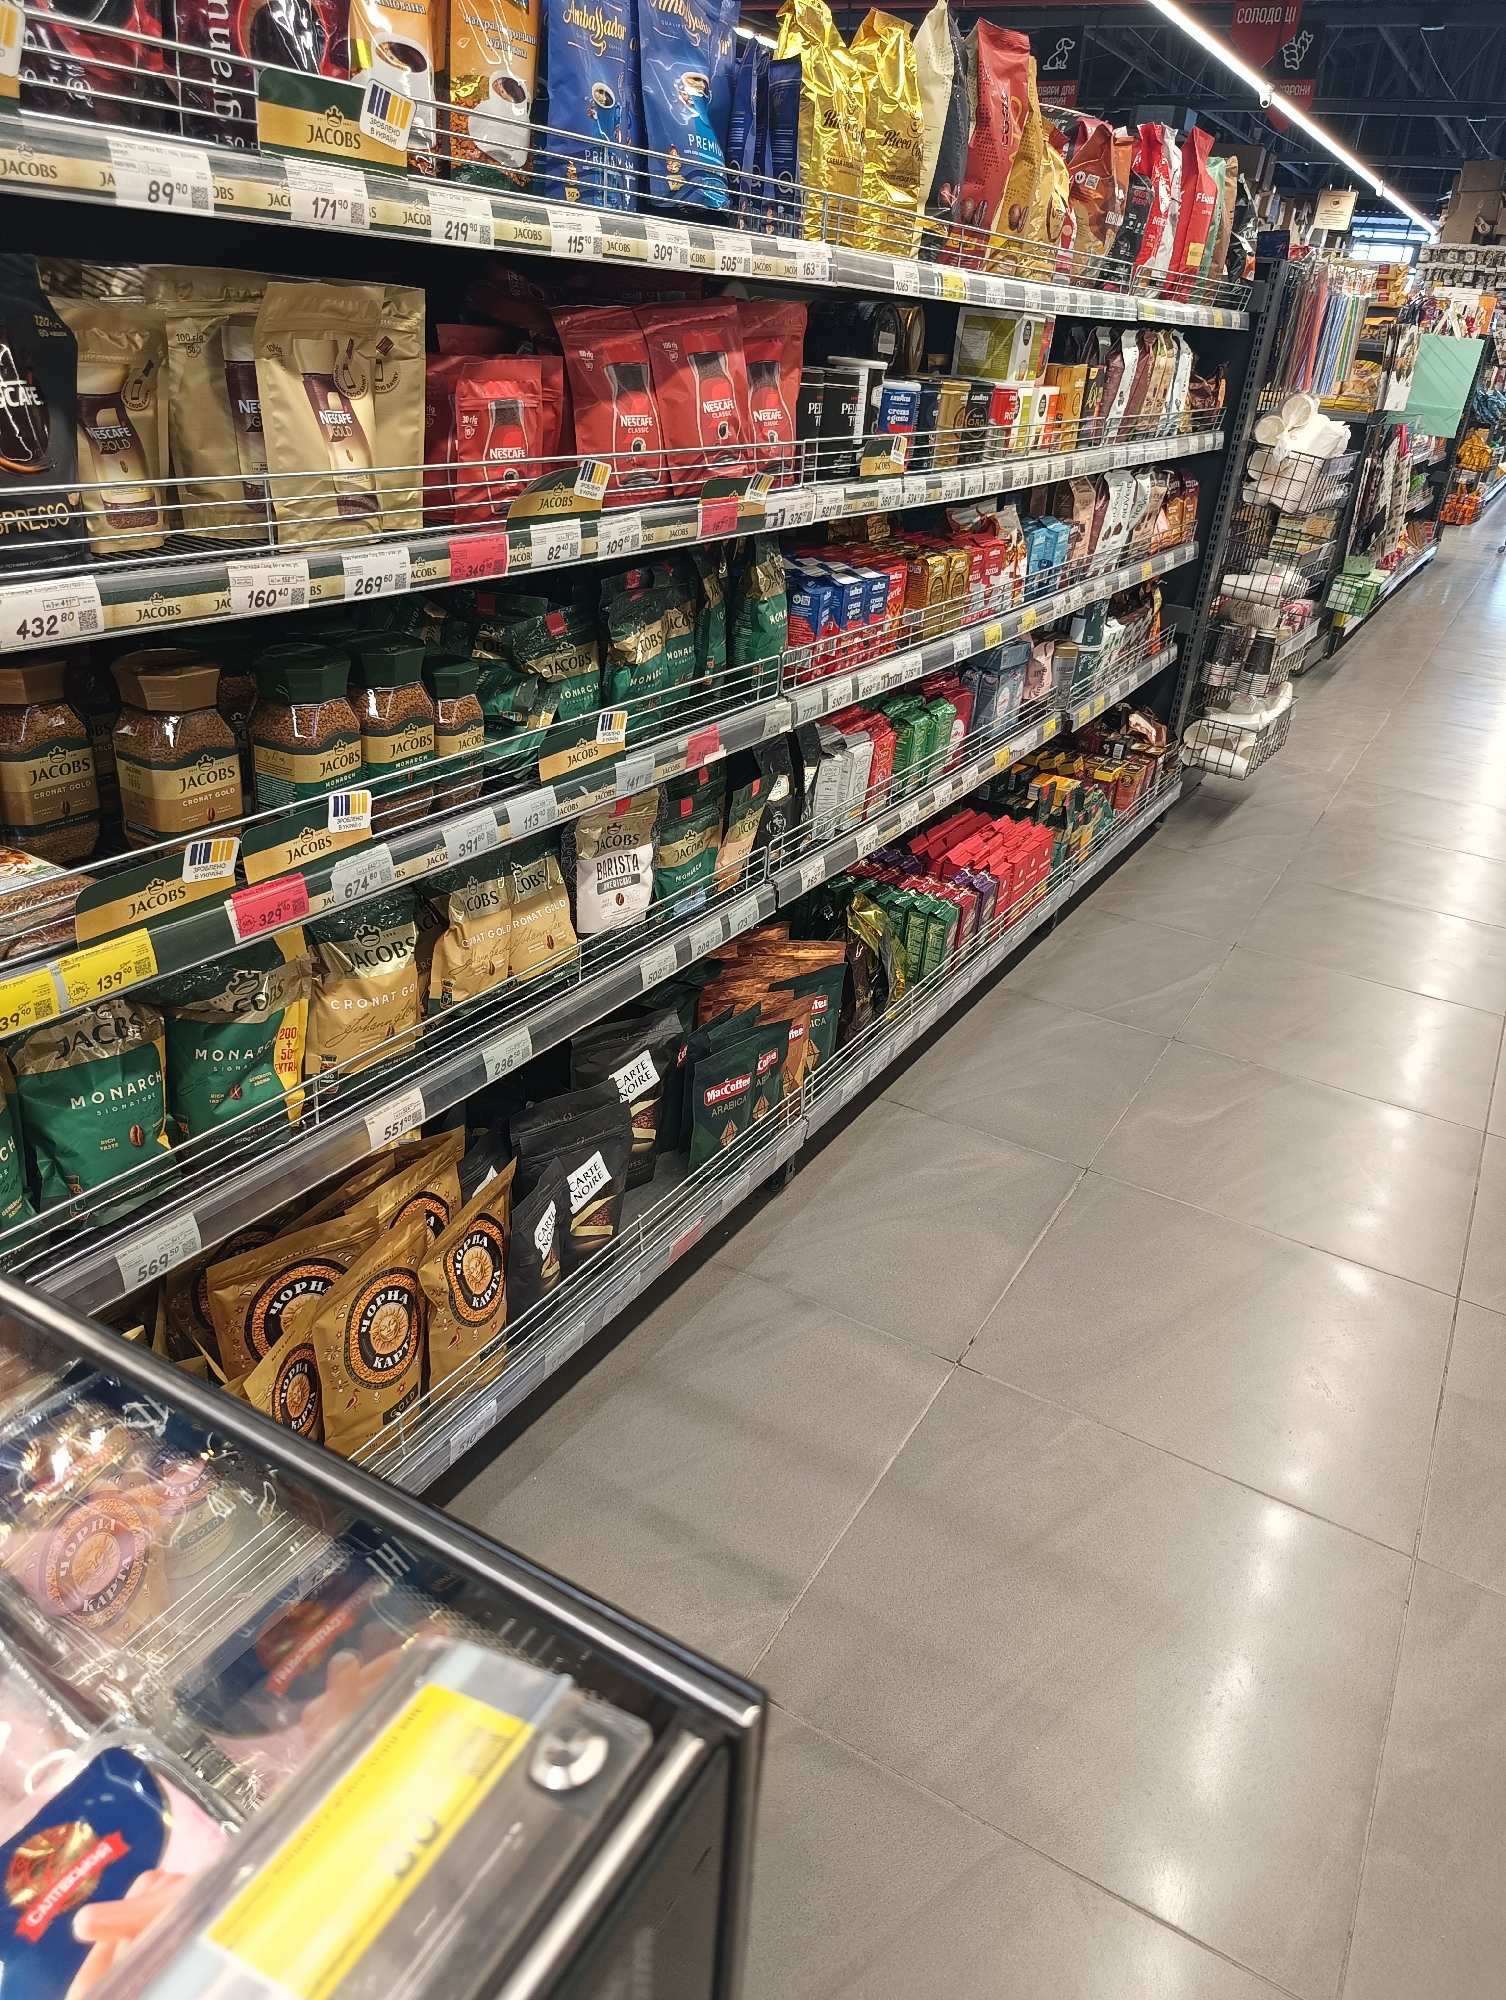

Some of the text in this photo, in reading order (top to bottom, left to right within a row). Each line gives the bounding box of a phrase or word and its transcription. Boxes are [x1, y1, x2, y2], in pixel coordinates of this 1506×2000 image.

[307, 124, 361, 150] JACOBS
[369, 117, 401, 138] ЗРОБЛЕНО
[370, 127, 398, 146] В УКРАЇНІ
[0, 158, 58, 180] JACOBS
[402, 211, 432, 227] JACOB
[513, 226, 543, 241] JACOBS
[606, 240, 631, 253] JACOBS
[753, 260, 772, 273] JACOBS
[711, 410, 733, 419] CLASSIC
[331, 425, 353, 438] GOLD
[627, 426, 650, 434] CLASSIC
[101, 438, 131, 453] GOLD
[537, 495, 574, 512] JACOBS
[0, 502, 70, 536] PRESSO
[668, 527, 689, 540] JACOBS
[410, 566, 437, 580] ACOBS
[135, 604, 182, 622] JACOBS
[214, 597, 232, 612] JAC
[389, 733, 433, 759] JACOBS
[567, 745, 599, 768] JACOBS
[29, 757, 91, 787] JACOBS
[319, 749, 361, 778] JACOBS
[394, 753, 428, 769] MONARCH
[661, 761, 682, 778] JACOBS
[33, 780, 92, 801] CRONAT GOLD
[179, 765, 236, 795] JACOBS
[325, 772, 357, 790] MONARCH
[182, 787, 236, 808] CRONAT GOLD
[594, 787, 615, 804] JACOBS
[336, 814, 364, 825] ЗРОБЛЕНО
[556, 801, 579, 818] JACOBS
[286, 834, 333, 865] JACOBS
[594, 832, 640, 856] JACOBS
[192, 862, 227, 874] ЗРОБЛЕНО
[199, 870, 224, 880] УКРАЇНІ
[596, 853, 640, 881] BARISTA
[674, 861, 704, 883] MONARCH
[128, 884, 187, 920] JACOBS
[465, 888, 501, 914] COBS
[512, 899, 567, 930] RONAT GOLD
[330, 989, 398, 1012] CRONAT
[0, 1012, 20, 1033] 39
[278, 1026, 298, 1041] 200
[54, 1011, 147, 1060] JACBS
[757, 1049, 778, 1071] Coffee
[616, 1058, 650, 1091] CARTE
[70, 1070, 163, 1110] MONARCH
[619, 1070, 653, 1102] NOIRE
[706, 1077, 751, 1103] MacCoffee
[96, 1091, 157, 1116] SIGNATURE
[710, 1095, 748, 1119] ARABICA
[568, 1160, 601, 1193] CARTE
[573, 1169, 605, 1203] NOIRE
[455, 1233, 489, 1276] ЧОРНА
[268, 1279, 332, 1316] ЧОРНА
[471, 1269, 502, 1308] КАРТА
[360, 1289, 409, 1335] ЧОРНА
[59, 1517, 117, 1578] ЧОРНА
[82, 1554, 132, 1612] КАРТА
